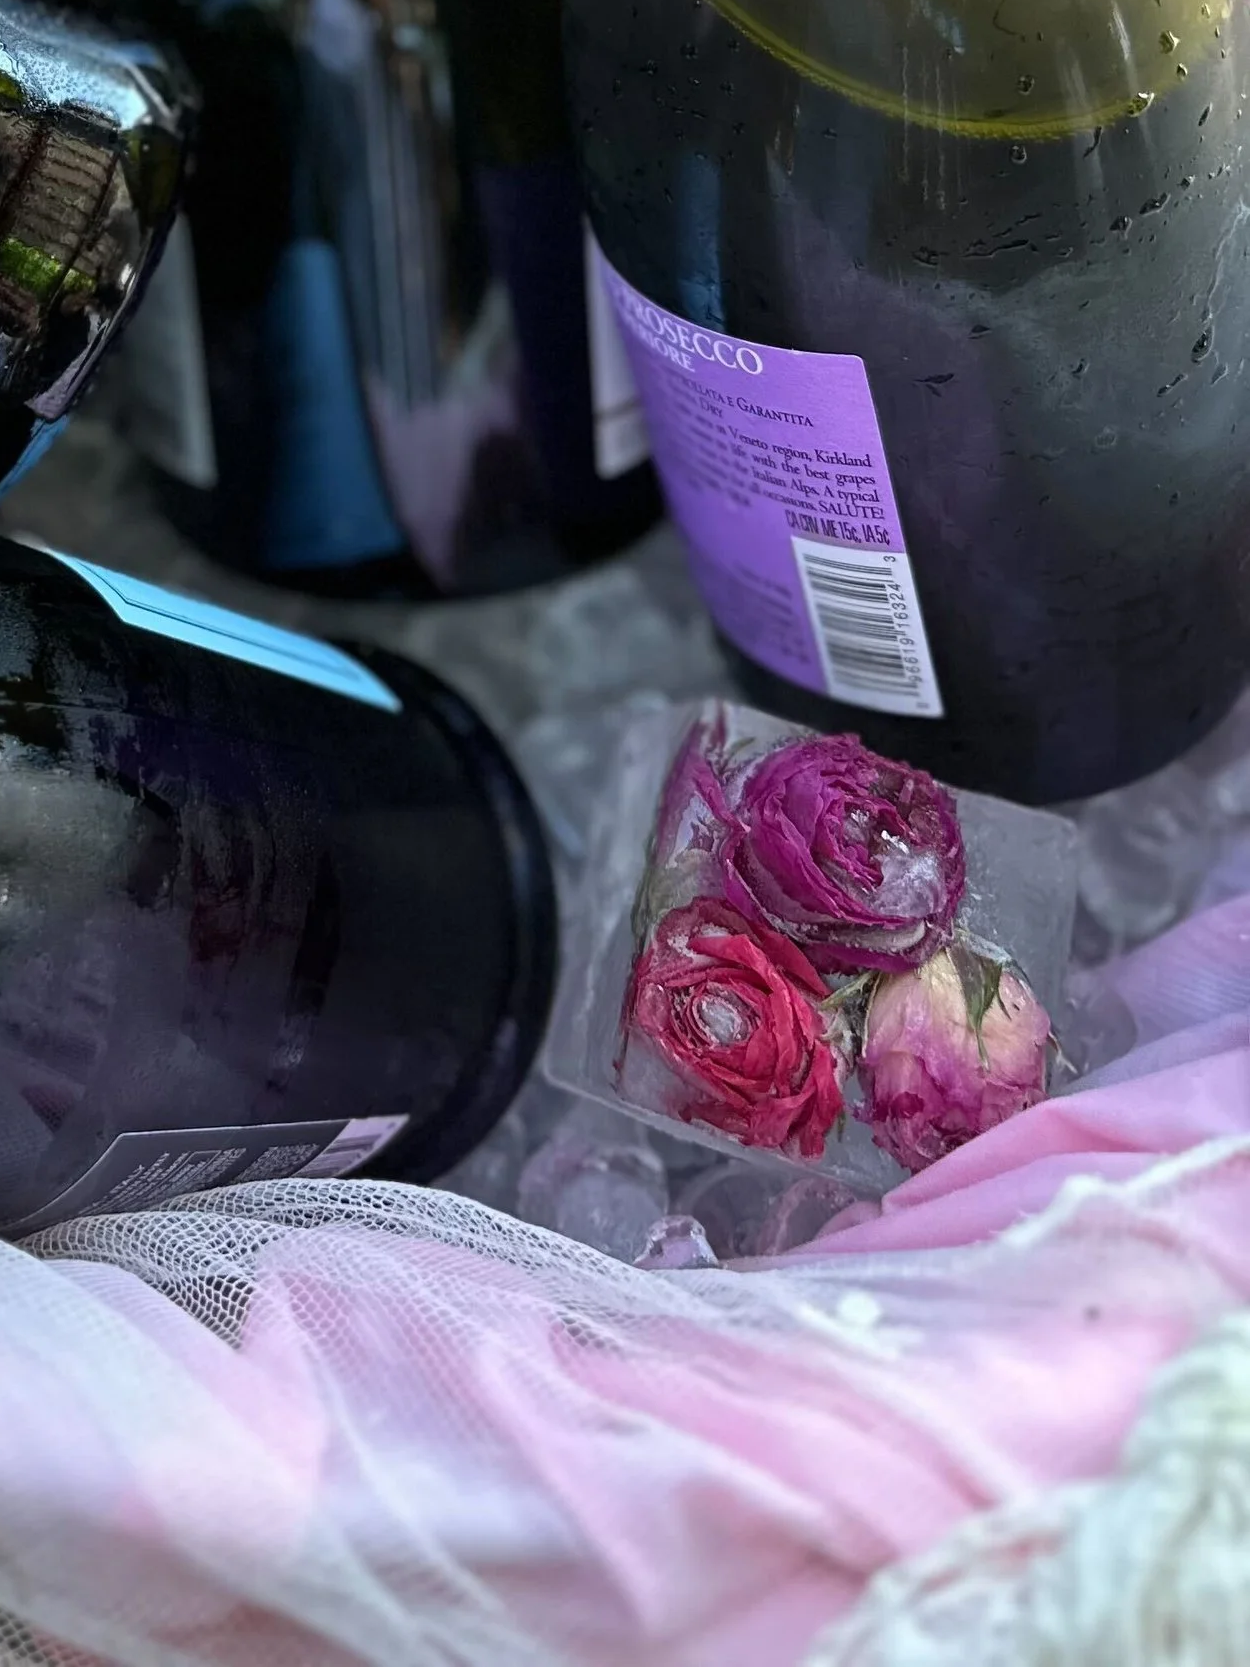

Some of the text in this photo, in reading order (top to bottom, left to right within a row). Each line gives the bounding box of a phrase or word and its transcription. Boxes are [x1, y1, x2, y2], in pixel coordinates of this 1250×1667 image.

[736, 397, 814, 428] GARANTITA
[728, 425, 768, 451] Veneto
[772, 444, 812, 462] region,
[814, 449, 872, 468] Kirkland
[752, 453, 778, 470] with
[781, 460, 801, 475] the
[803, 464, 831, 481] best
[835, 472, 876, 491] grapes
[818, 500, 886, 520] SALUTE!
[823, 485, 835, 498] A
[838, 489, 880, 506] typical
[820, 517, 839, 538] ME
[883, 555, 896, 563] 3
[887, 584, 910, 628] 16324
[900, 637, 923, 684] 96619
